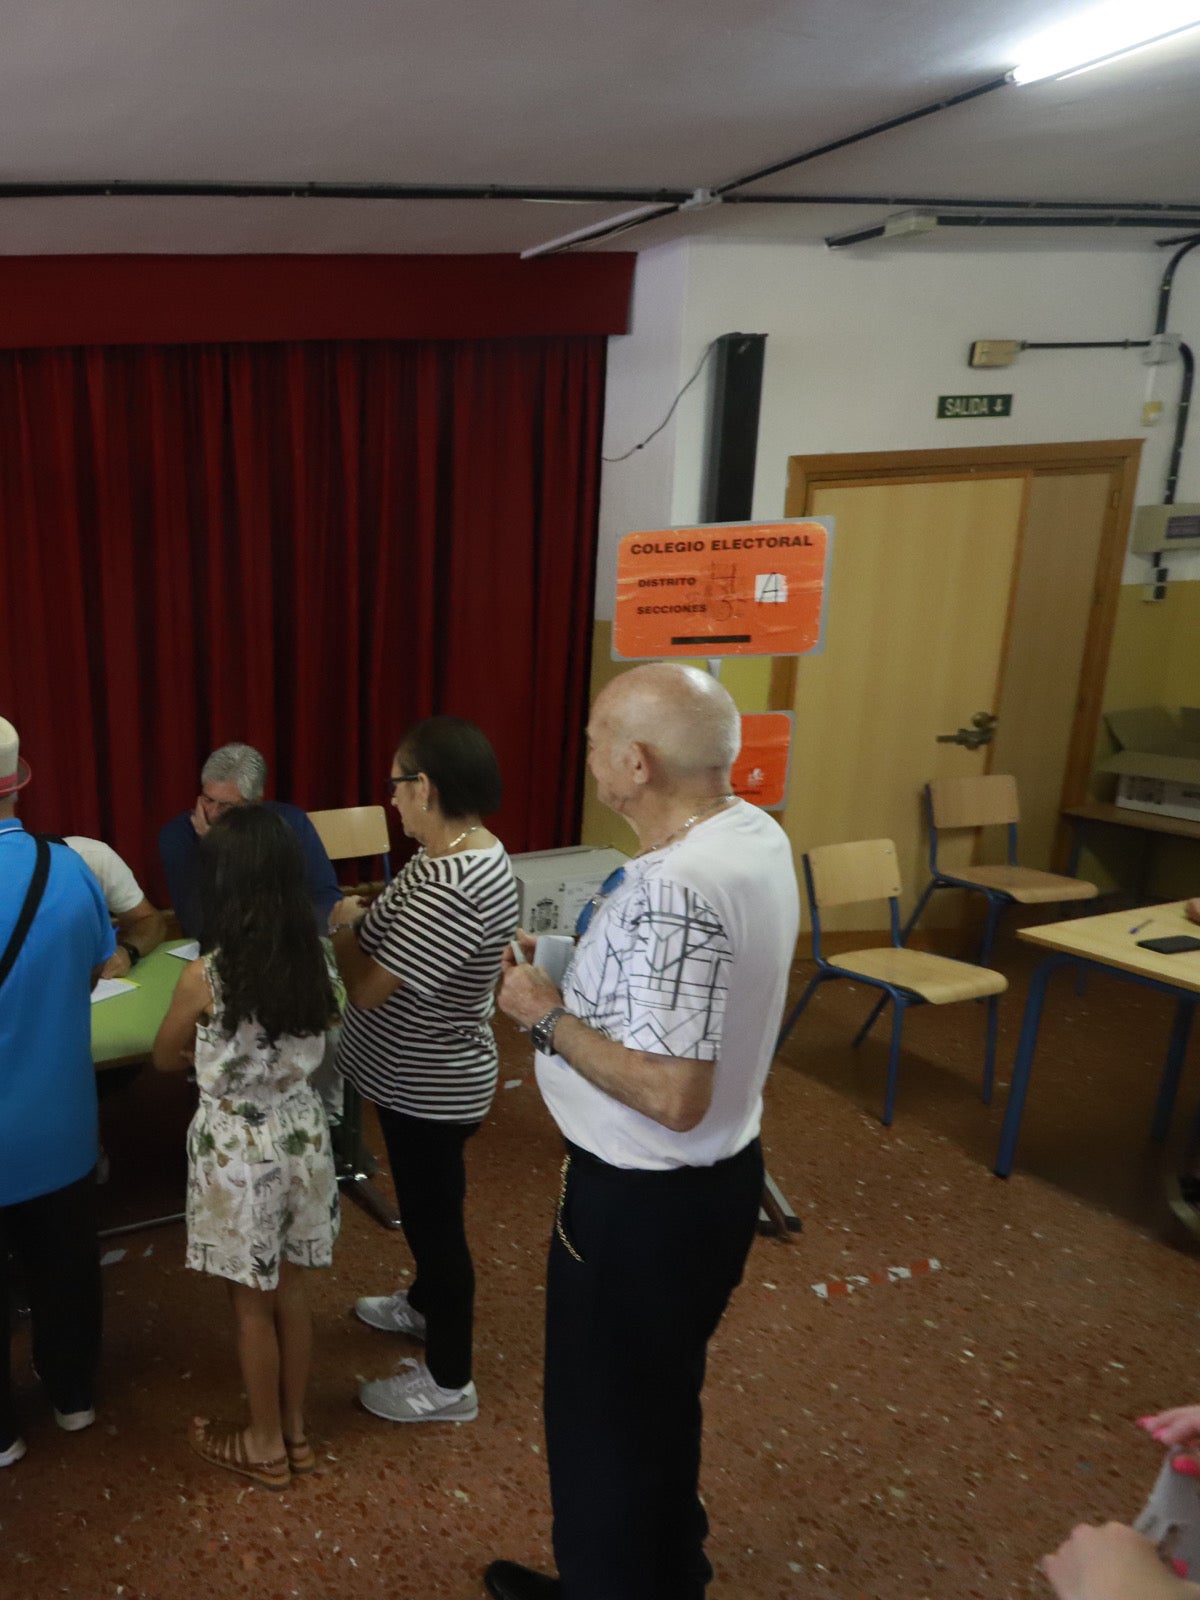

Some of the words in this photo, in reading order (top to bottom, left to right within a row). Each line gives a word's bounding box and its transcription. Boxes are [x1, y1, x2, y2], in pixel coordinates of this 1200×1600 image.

[945, 398, 988, 416] SALIDA
[630, 541, 704, 555] COLEGIO
[711, 535, 813, 550] ELECTORAL
[638, 577, 696, 588] DISTRITO
[636, 603, 707, 615] SECCIONES
[393, 1312, 413, 1327] N
[406, 1394, 436, 1415] N
